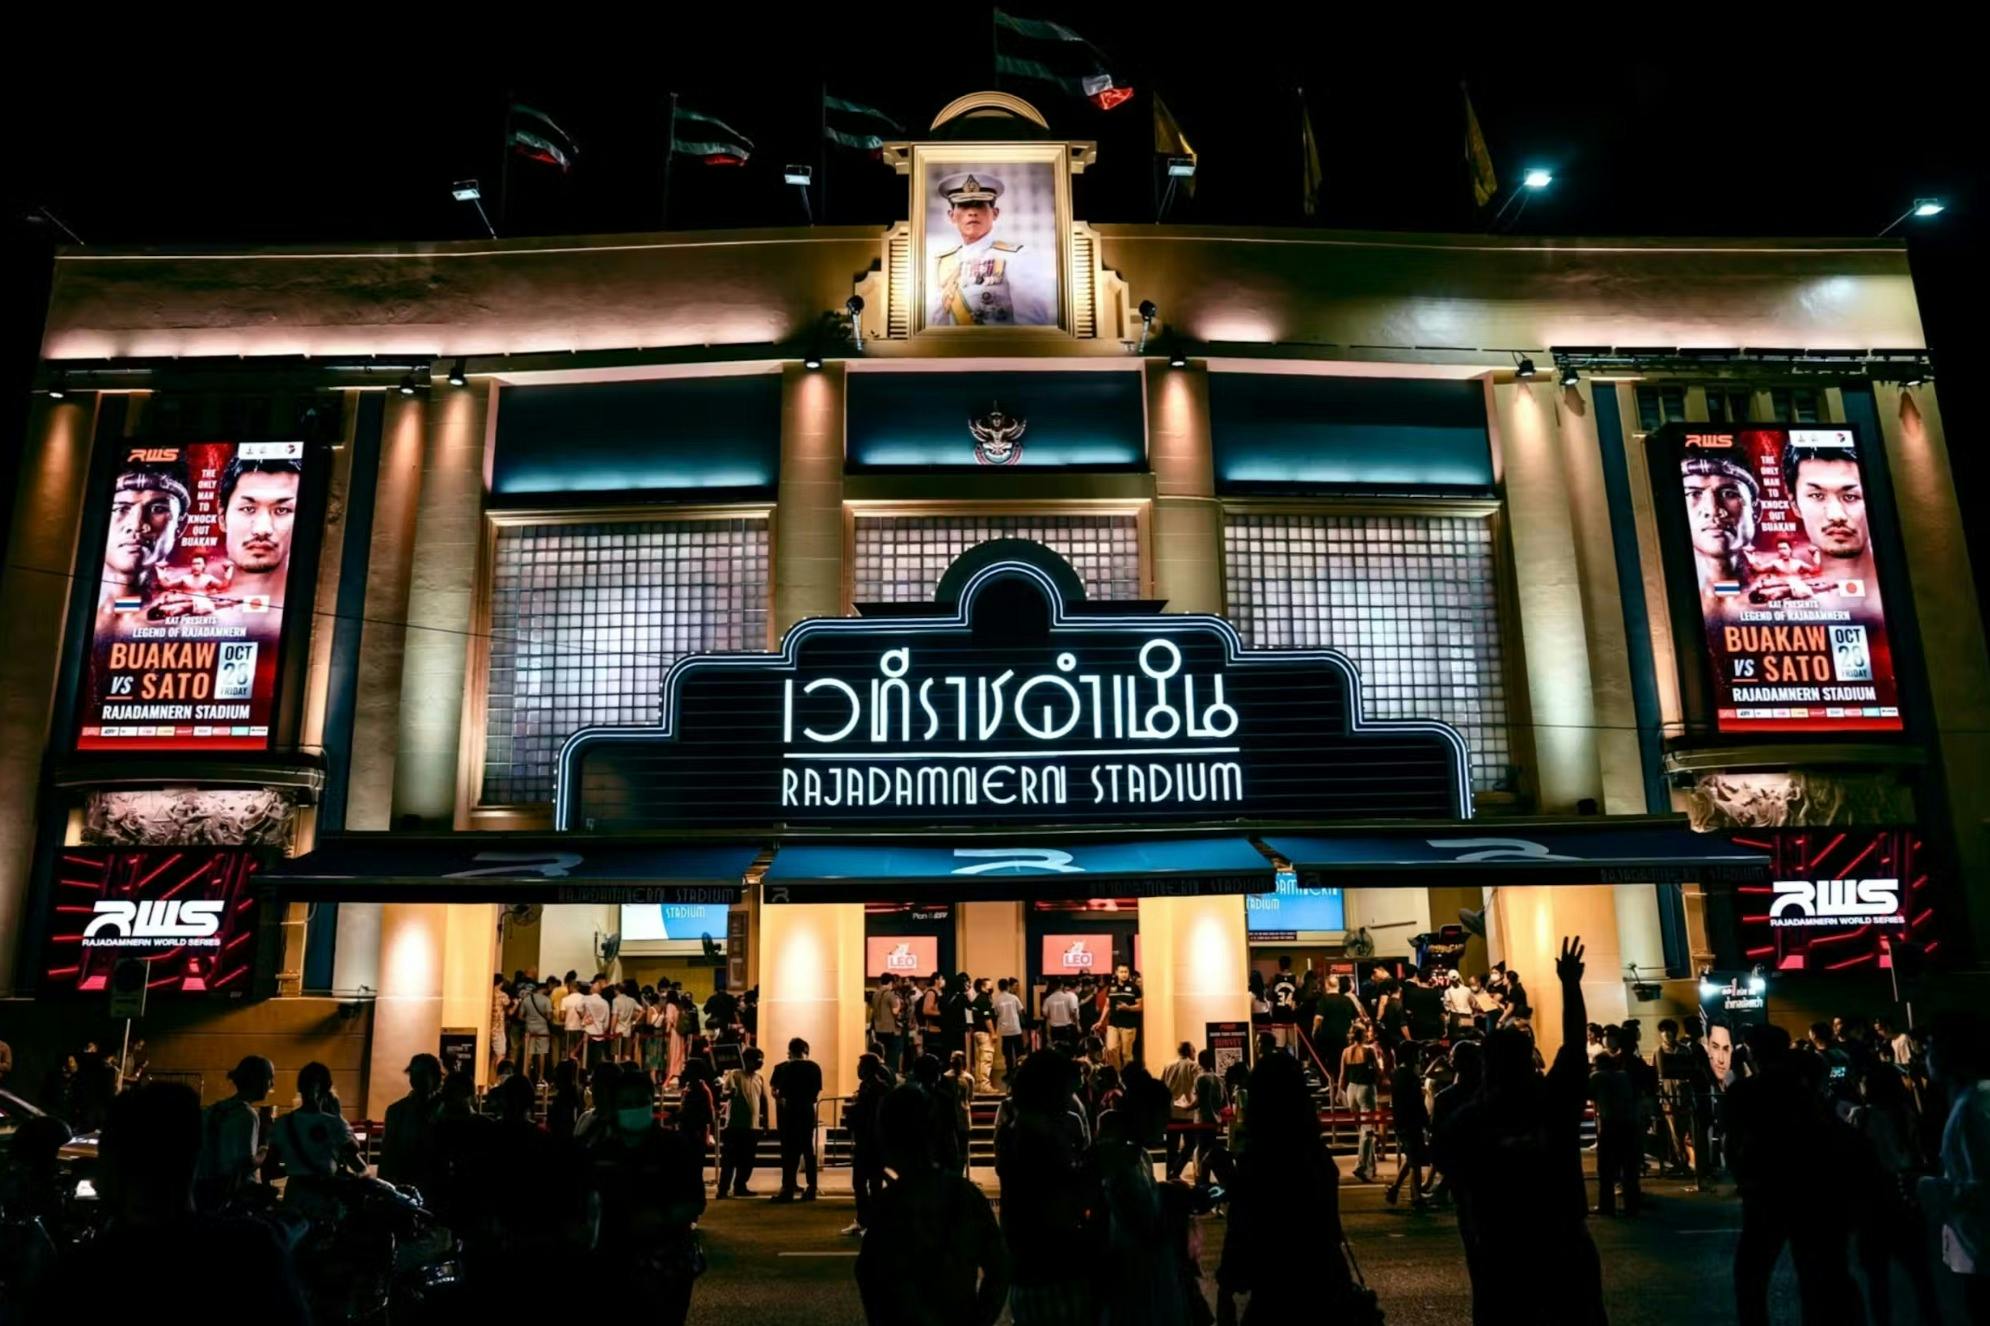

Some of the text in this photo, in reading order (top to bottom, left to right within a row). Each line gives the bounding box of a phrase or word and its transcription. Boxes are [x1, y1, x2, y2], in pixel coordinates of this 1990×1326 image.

[1684, 434, 1734, 448] RWS
[127, 448, 179, 463] RWS
[1760, 455, 1775, 465] THE
[202, 468, 216, 478] THE
[197, 480, 217, 489] ONLY
[197, 491, 214, 500] MAN
[1767, 488, 1779, 498] TO
[199, 502, 210, 512] TO
[1760, 500, 1790, 510] KNOCK
[187, 514, 217, 524] KNOCK
[1769, 511, 1785, 521] OUT
[192, 525, 210, 536] OUT
[1761, 522, 1796, 532] BUAKAW
[181, 536, 218, 547] BUAKAW
[180, 615, 217, 624] PRESENTS
[1740, 610, 1851, 621] LEGEND OF RAJADAMNERN
[133, 626, 247, 638] LEGEND OF RAJADAMNERN
[1835, 628, 1861, 644] OCT
[1724, 625, 1826, 652] BUAKAW
[109, 642, 216, 669] BUAKAW
[225, 645, 252, 661] OCT
[1734, 655, 1830, 682] VS SATO
[1842, 669, 1868, 678] FRIDAY
[110, 672, 210, 699] VS SATO
[220, 687, 248, 696] FRIDAY
[1732, 686, 1877, 702] RAJADAMNERN STADIUM
[102, 704, 250, 720] RAJADAMNERN STADIUM
[782, 762, 1243, 807] RAJADAMNERN STADIUM
[676, 887, 735, 902] STADIUM
[1769, 879, 1899, 917] RWS
[1246, 898, 1280, 910] TADIUM
[666, 906, 705, 919] STADIUM
[83, 900, 226, 937] RWS
[1770, 914, 1906, 928] RAJADAMNERN WORLD SERIES
[82, 937, 221, 947] RAJADAMNERN WORLD SERIES
[890, 956, 915, 967] LEO
[1065, 954, 1091, 965] LEO
